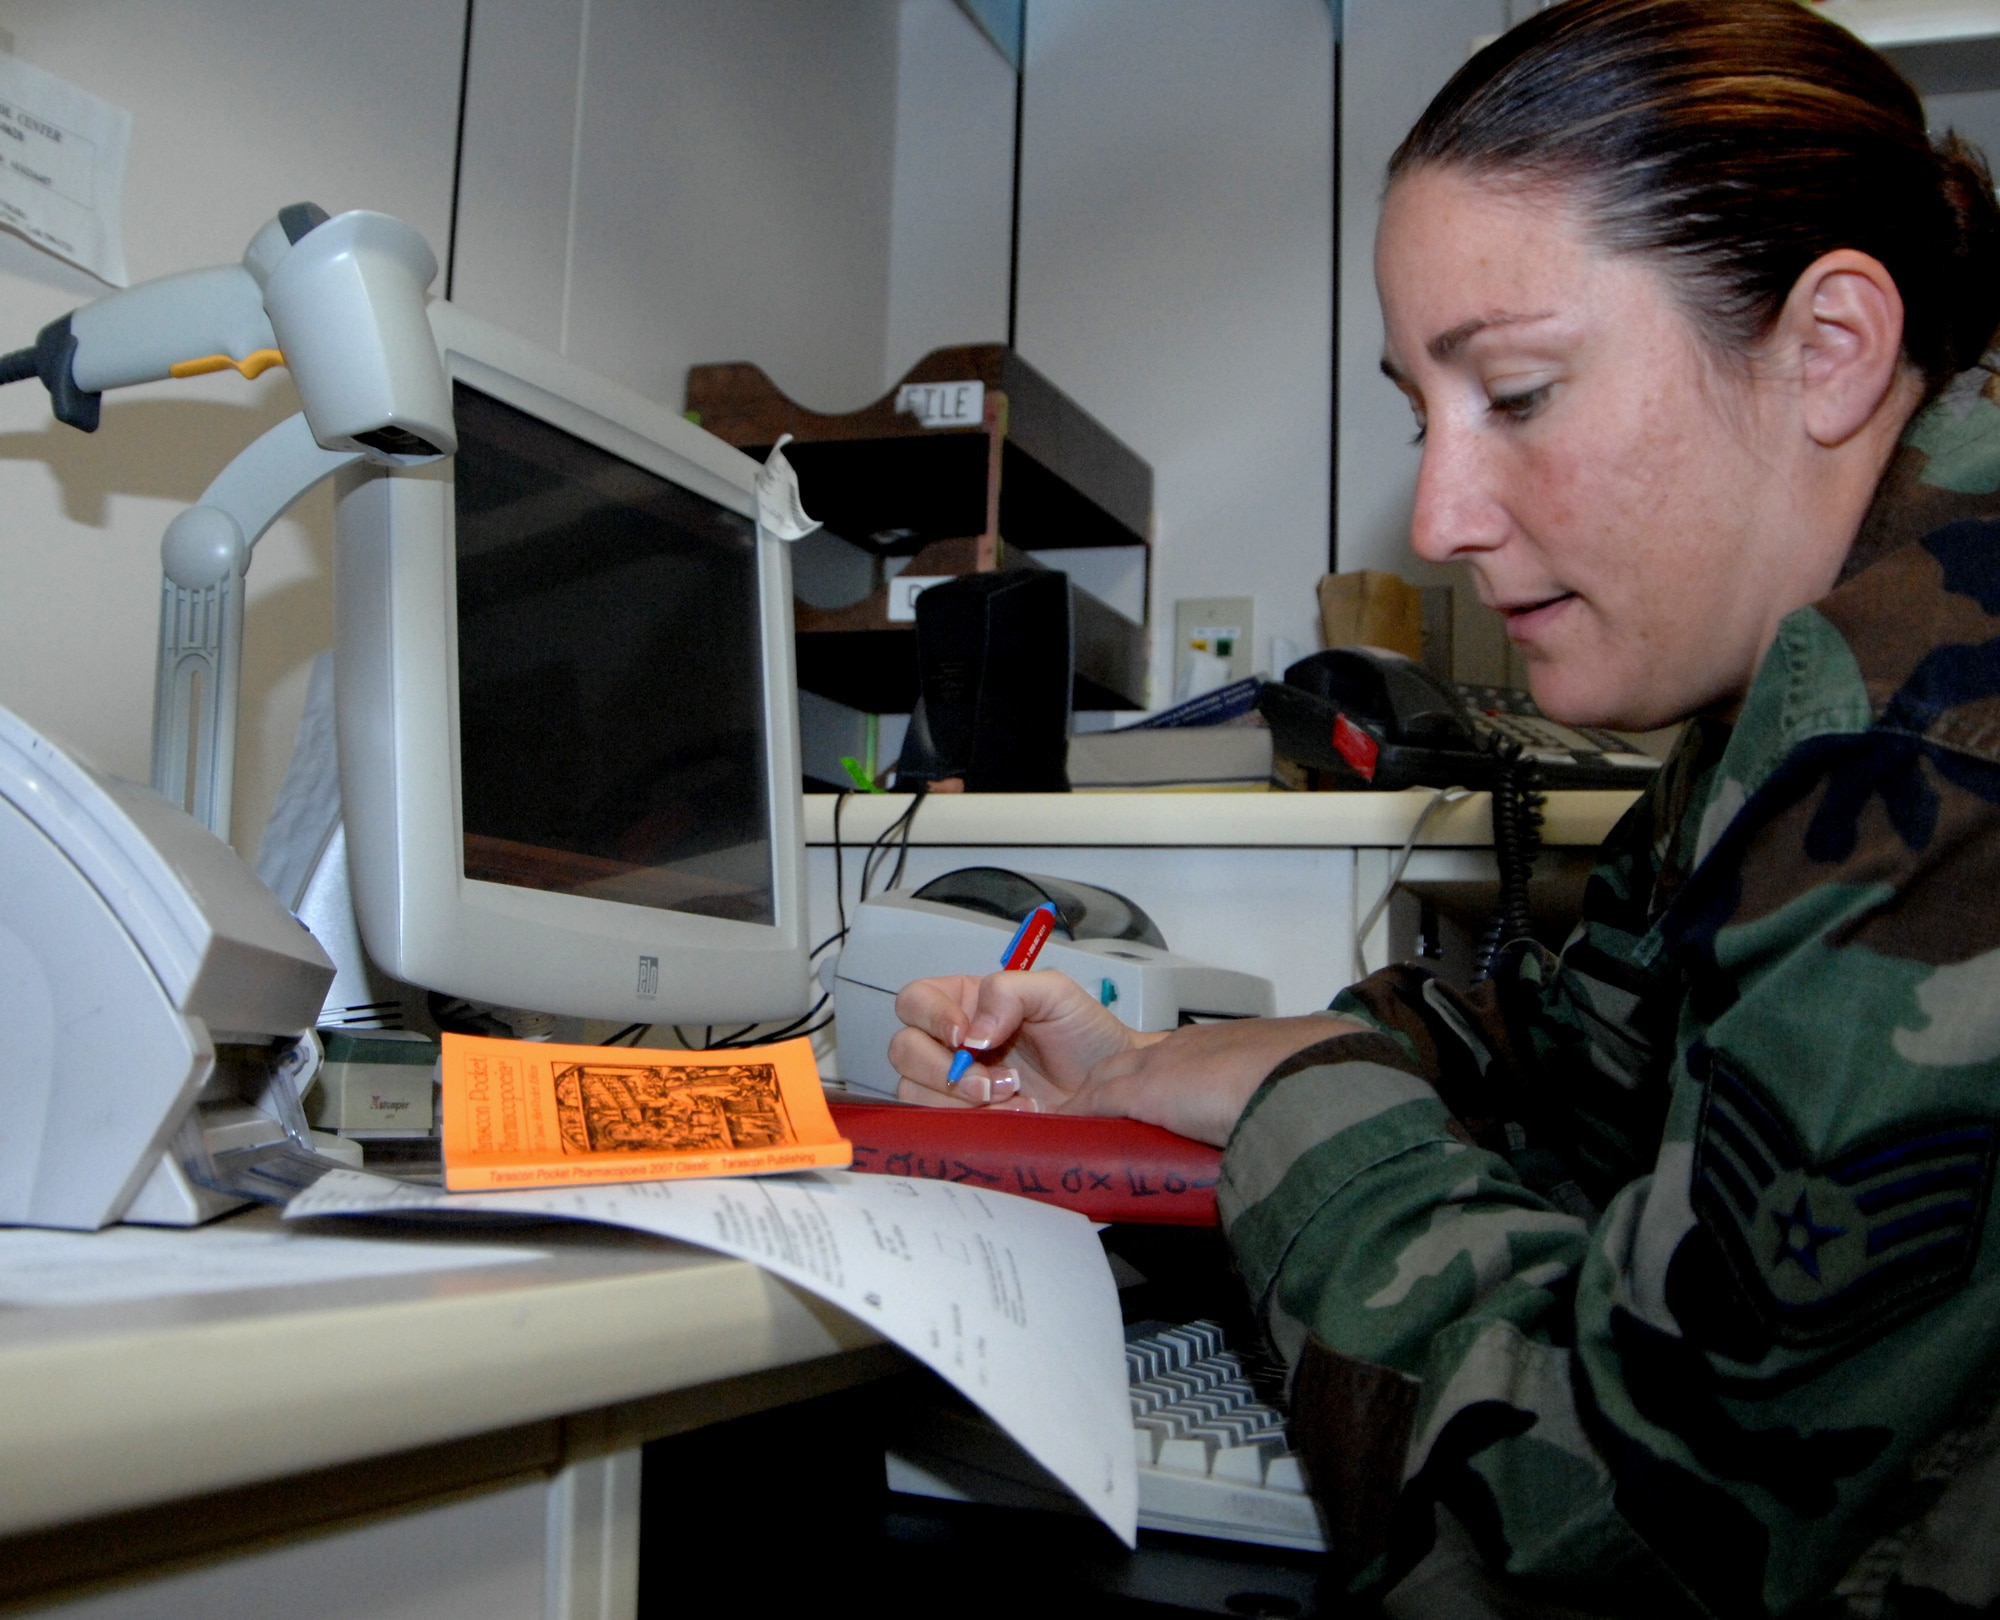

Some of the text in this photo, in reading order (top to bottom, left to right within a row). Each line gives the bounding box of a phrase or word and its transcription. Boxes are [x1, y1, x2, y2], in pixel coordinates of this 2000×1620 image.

[17, 113, 62, 143] CENTER
[906, 387, 970, 418] FILE
[468, 1058, 490, 1101] Pocket
[490, 1171, 534, 1183] Tarascon
[537, 1168, 570, 1181] Pocket
[650, 1162, 674, 1175] 2007
[676, 1159, 710, 1173] Classic
[721, 1157, 765, 1170] Tarascon
[767, 1153, 816, 1167] Publishing
